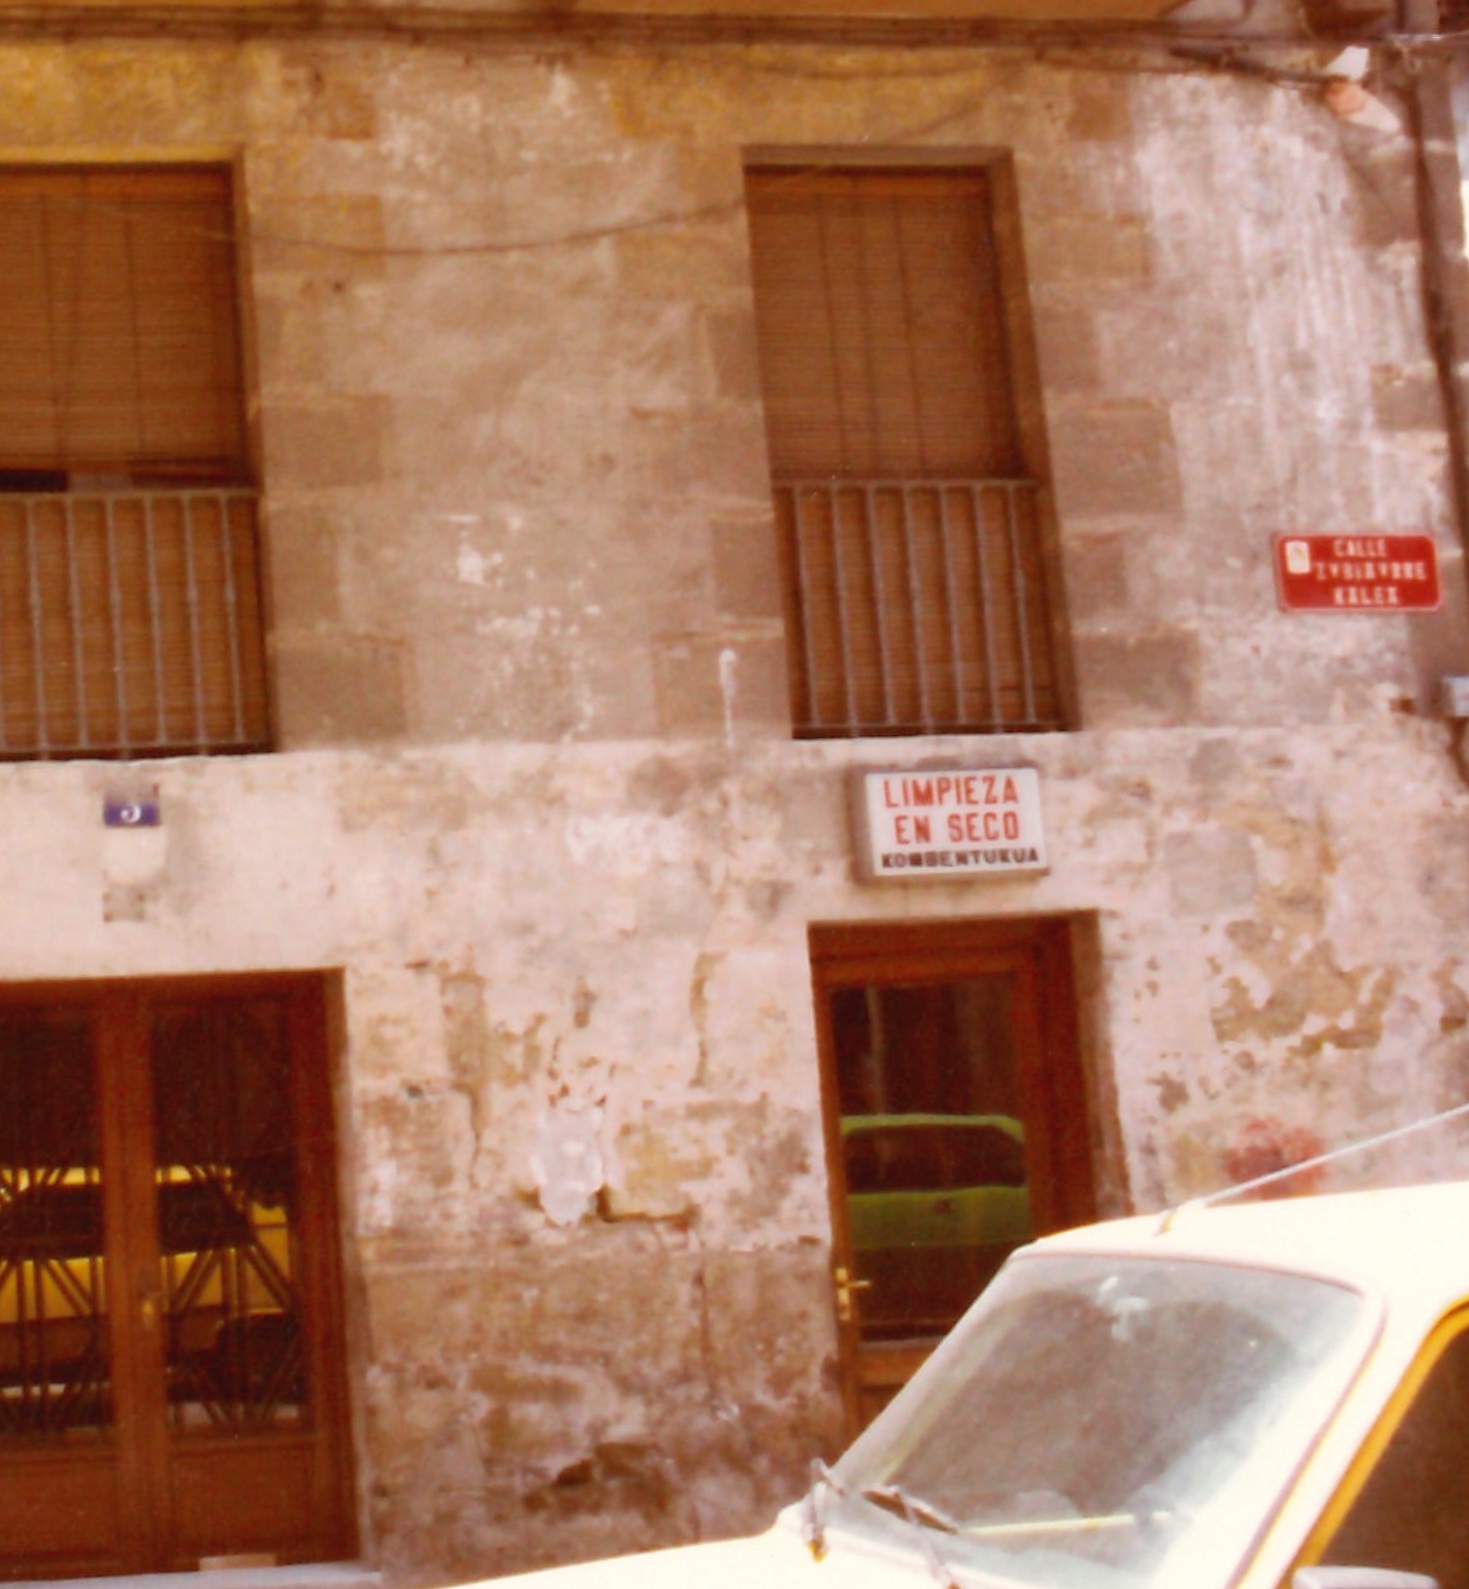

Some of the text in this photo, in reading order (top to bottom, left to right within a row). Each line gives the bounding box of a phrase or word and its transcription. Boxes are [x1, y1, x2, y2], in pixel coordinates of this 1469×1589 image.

[1333, 538, 1387, 558] CALLE
[883, 775, 1019, 808] LIMPIEZA
[894, 809, 1020, 845] EN SECO
